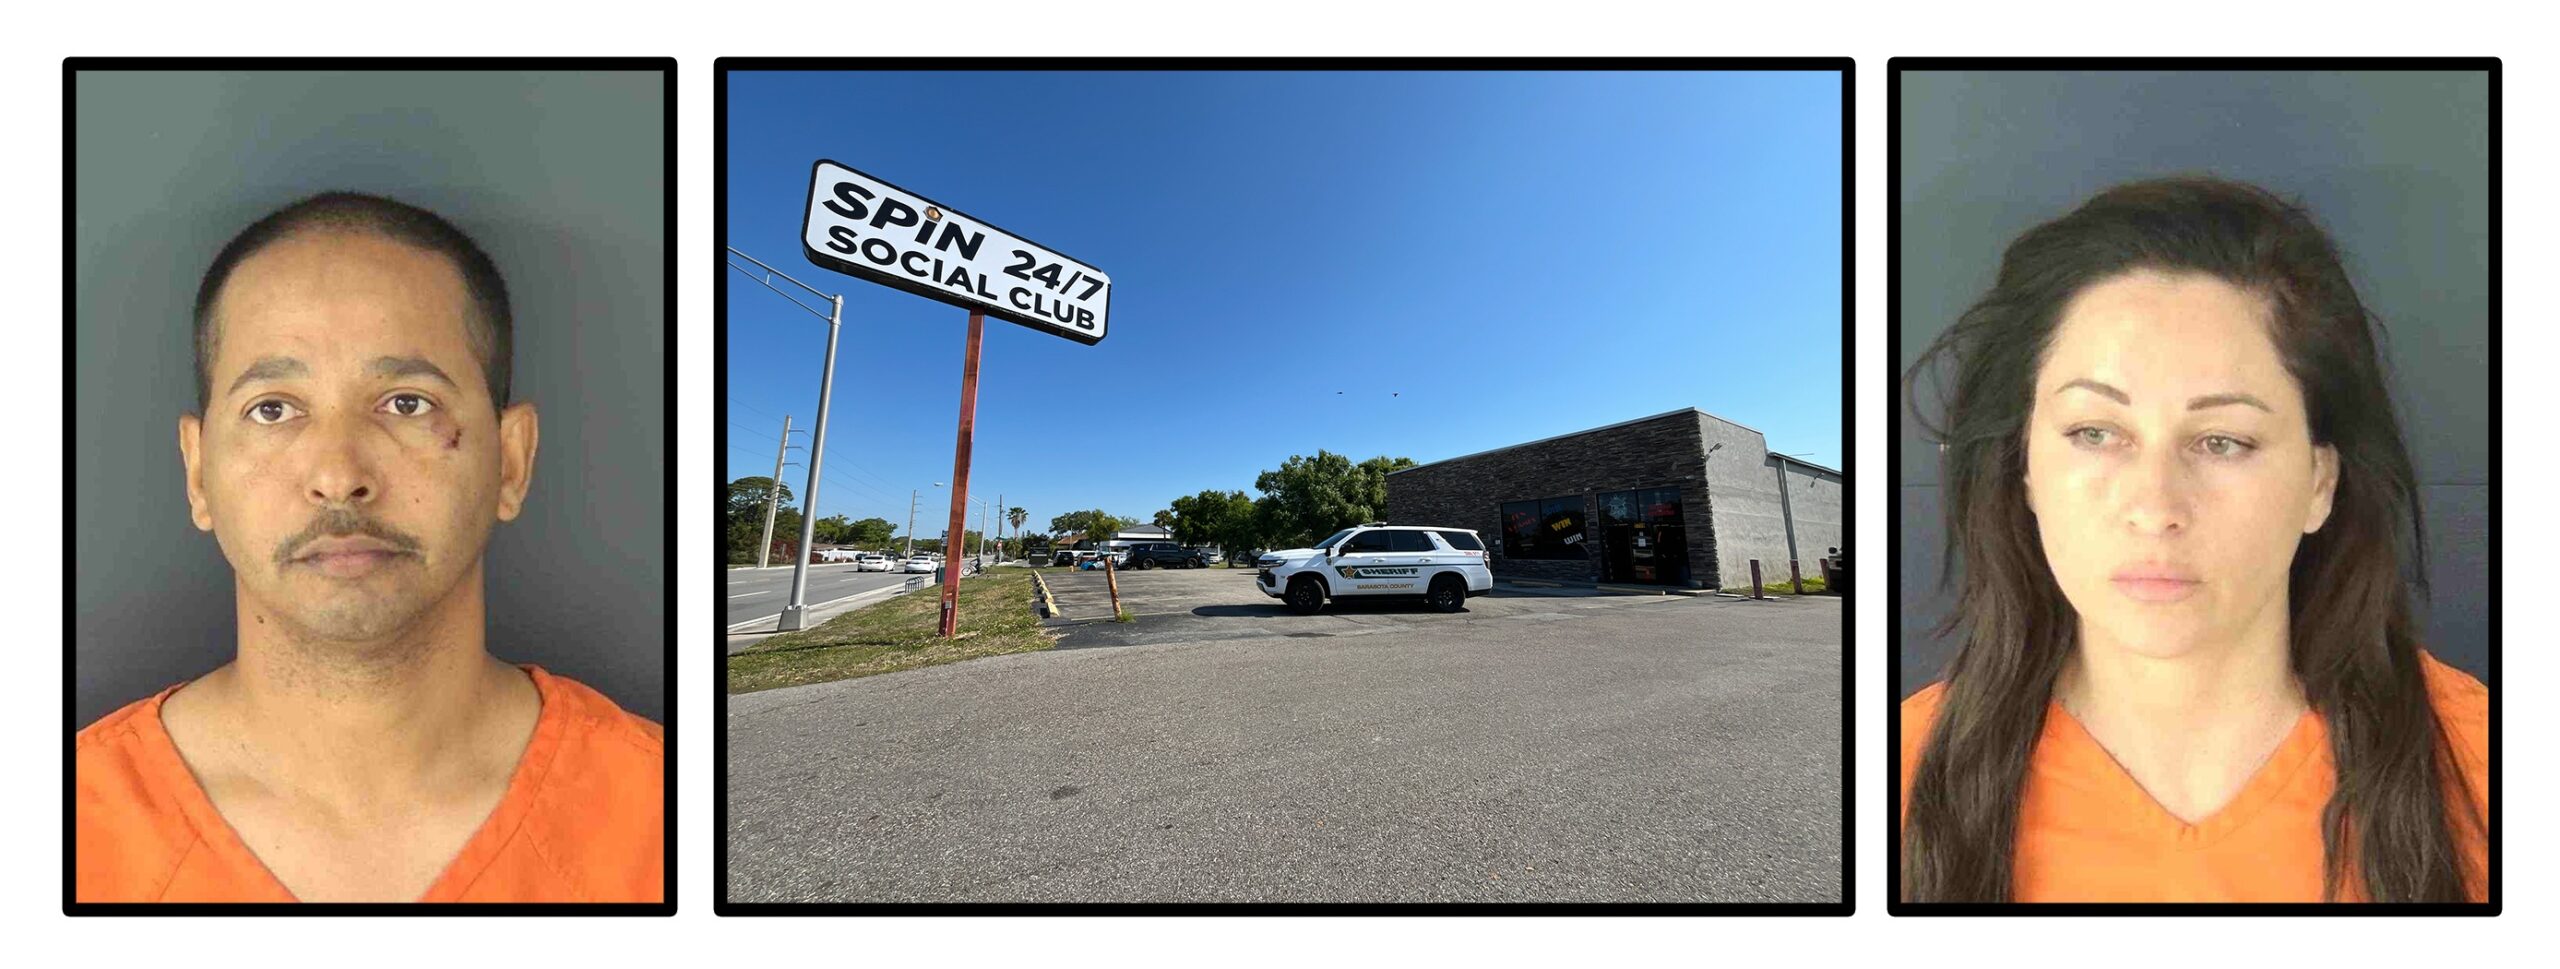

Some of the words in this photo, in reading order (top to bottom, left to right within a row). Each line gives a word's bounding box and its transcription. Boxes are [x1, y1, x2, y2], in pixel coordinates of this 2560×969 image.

[825, 225, 998, 301] SOCIAL
[1009, 287, 1095, 331] CLUB
[1003, 250, 1103, 301] 24/7
[1551, 517, 1572, 532] WIN
[1563, 532, 1583, 545] WIN
